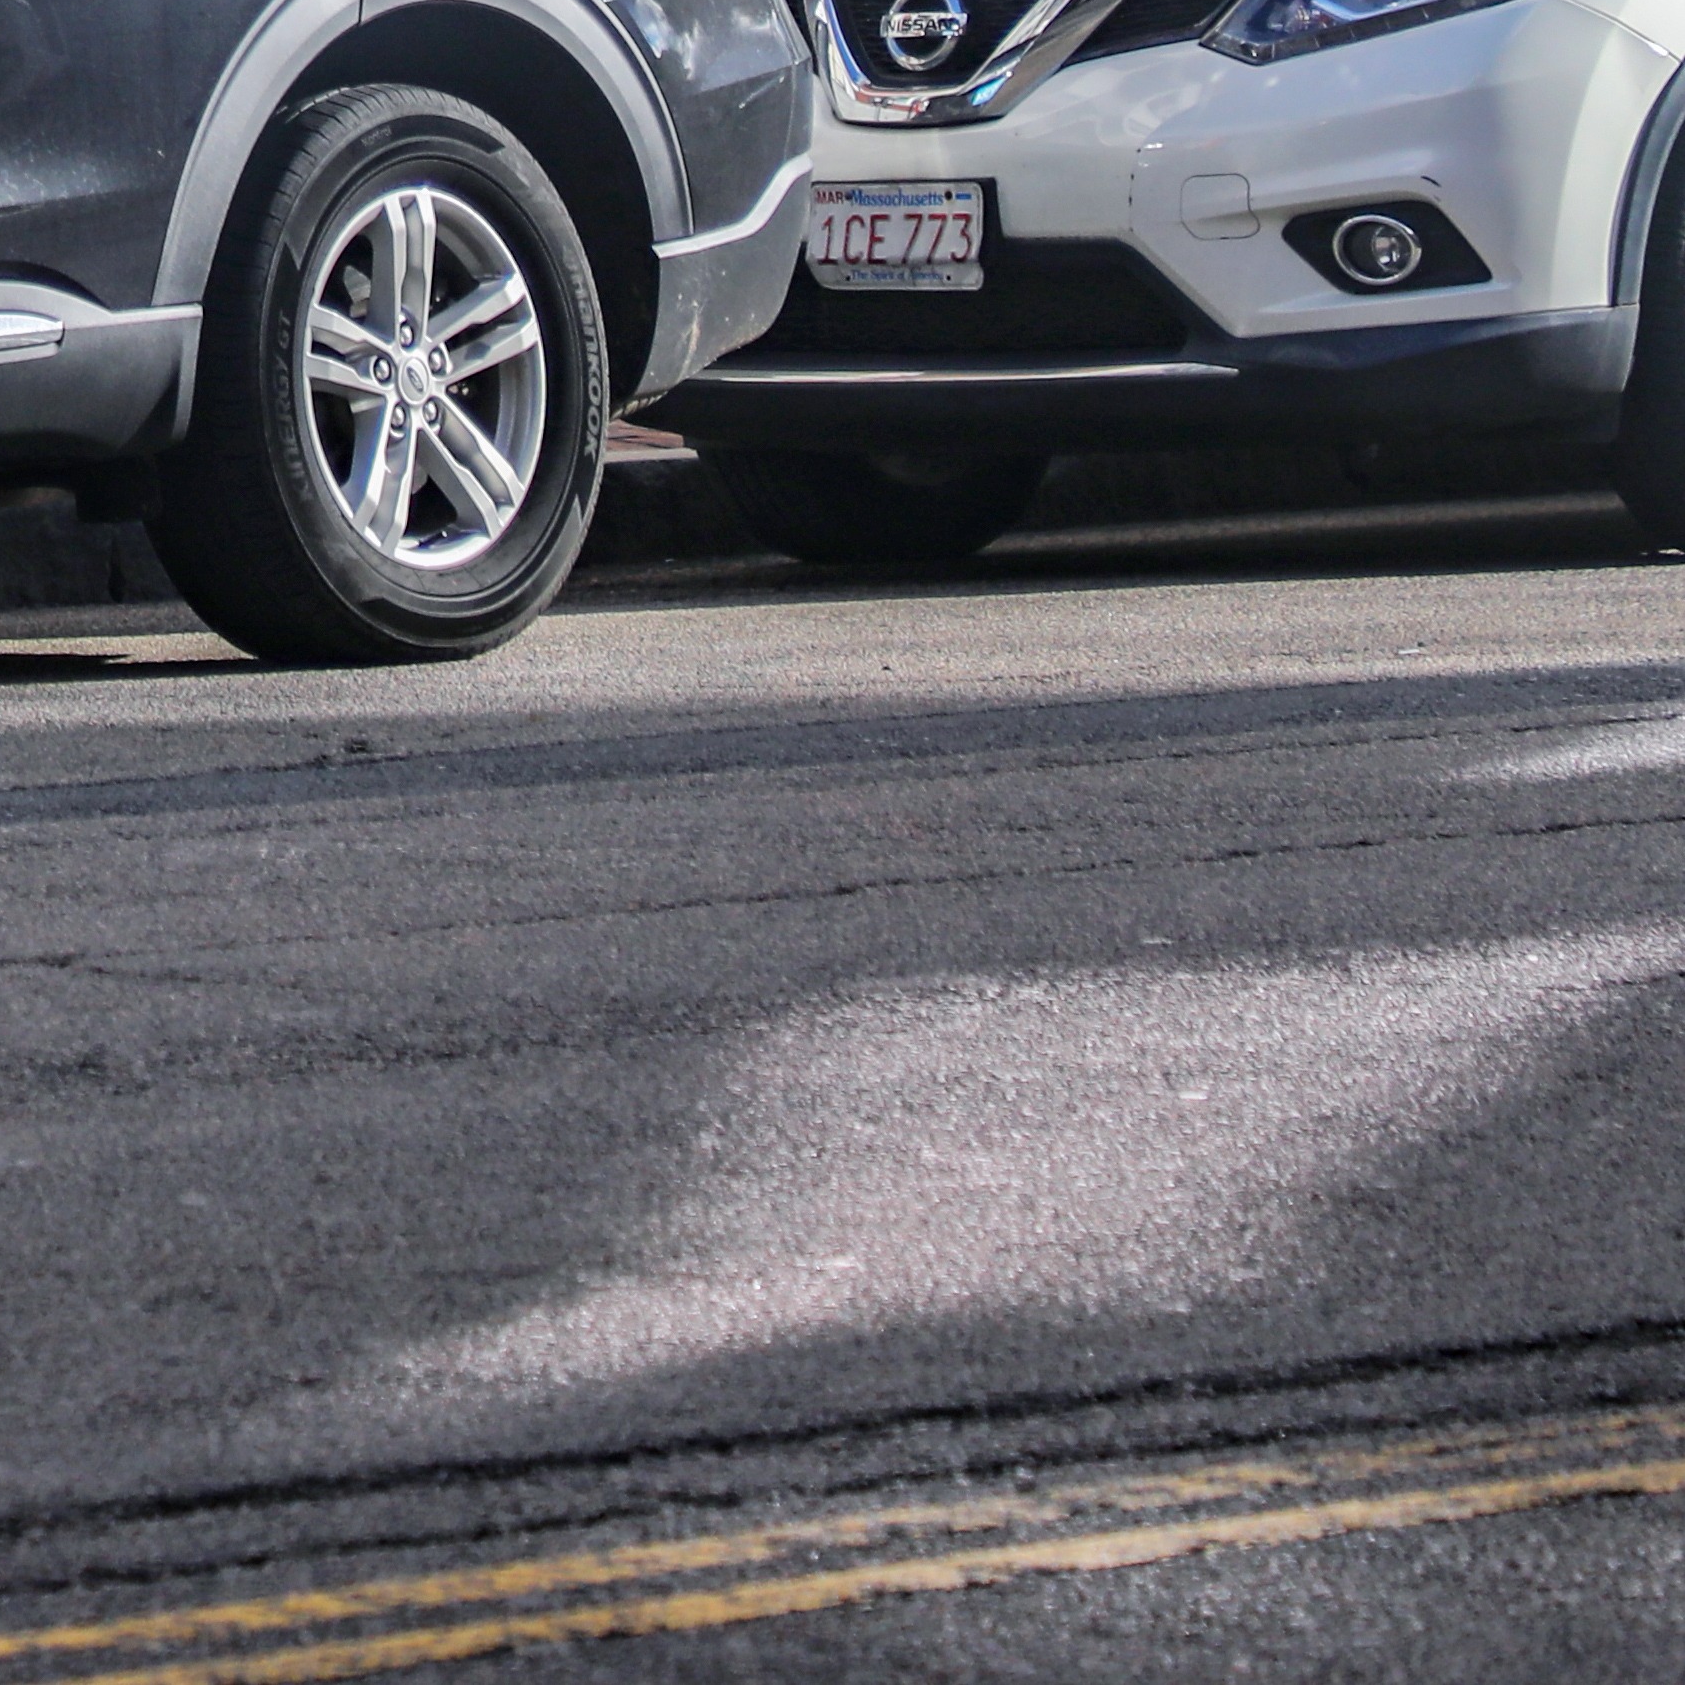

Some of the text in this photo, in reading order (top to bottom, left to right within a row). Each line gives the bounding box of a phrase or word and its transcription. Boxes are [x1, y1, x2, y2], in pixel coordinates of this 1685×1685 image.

[886, 17, 959, 33] NISSAN
[814, 187, 944, 208] MAR Massachusetts
[816, 212, 973, 265] 1CE 773
